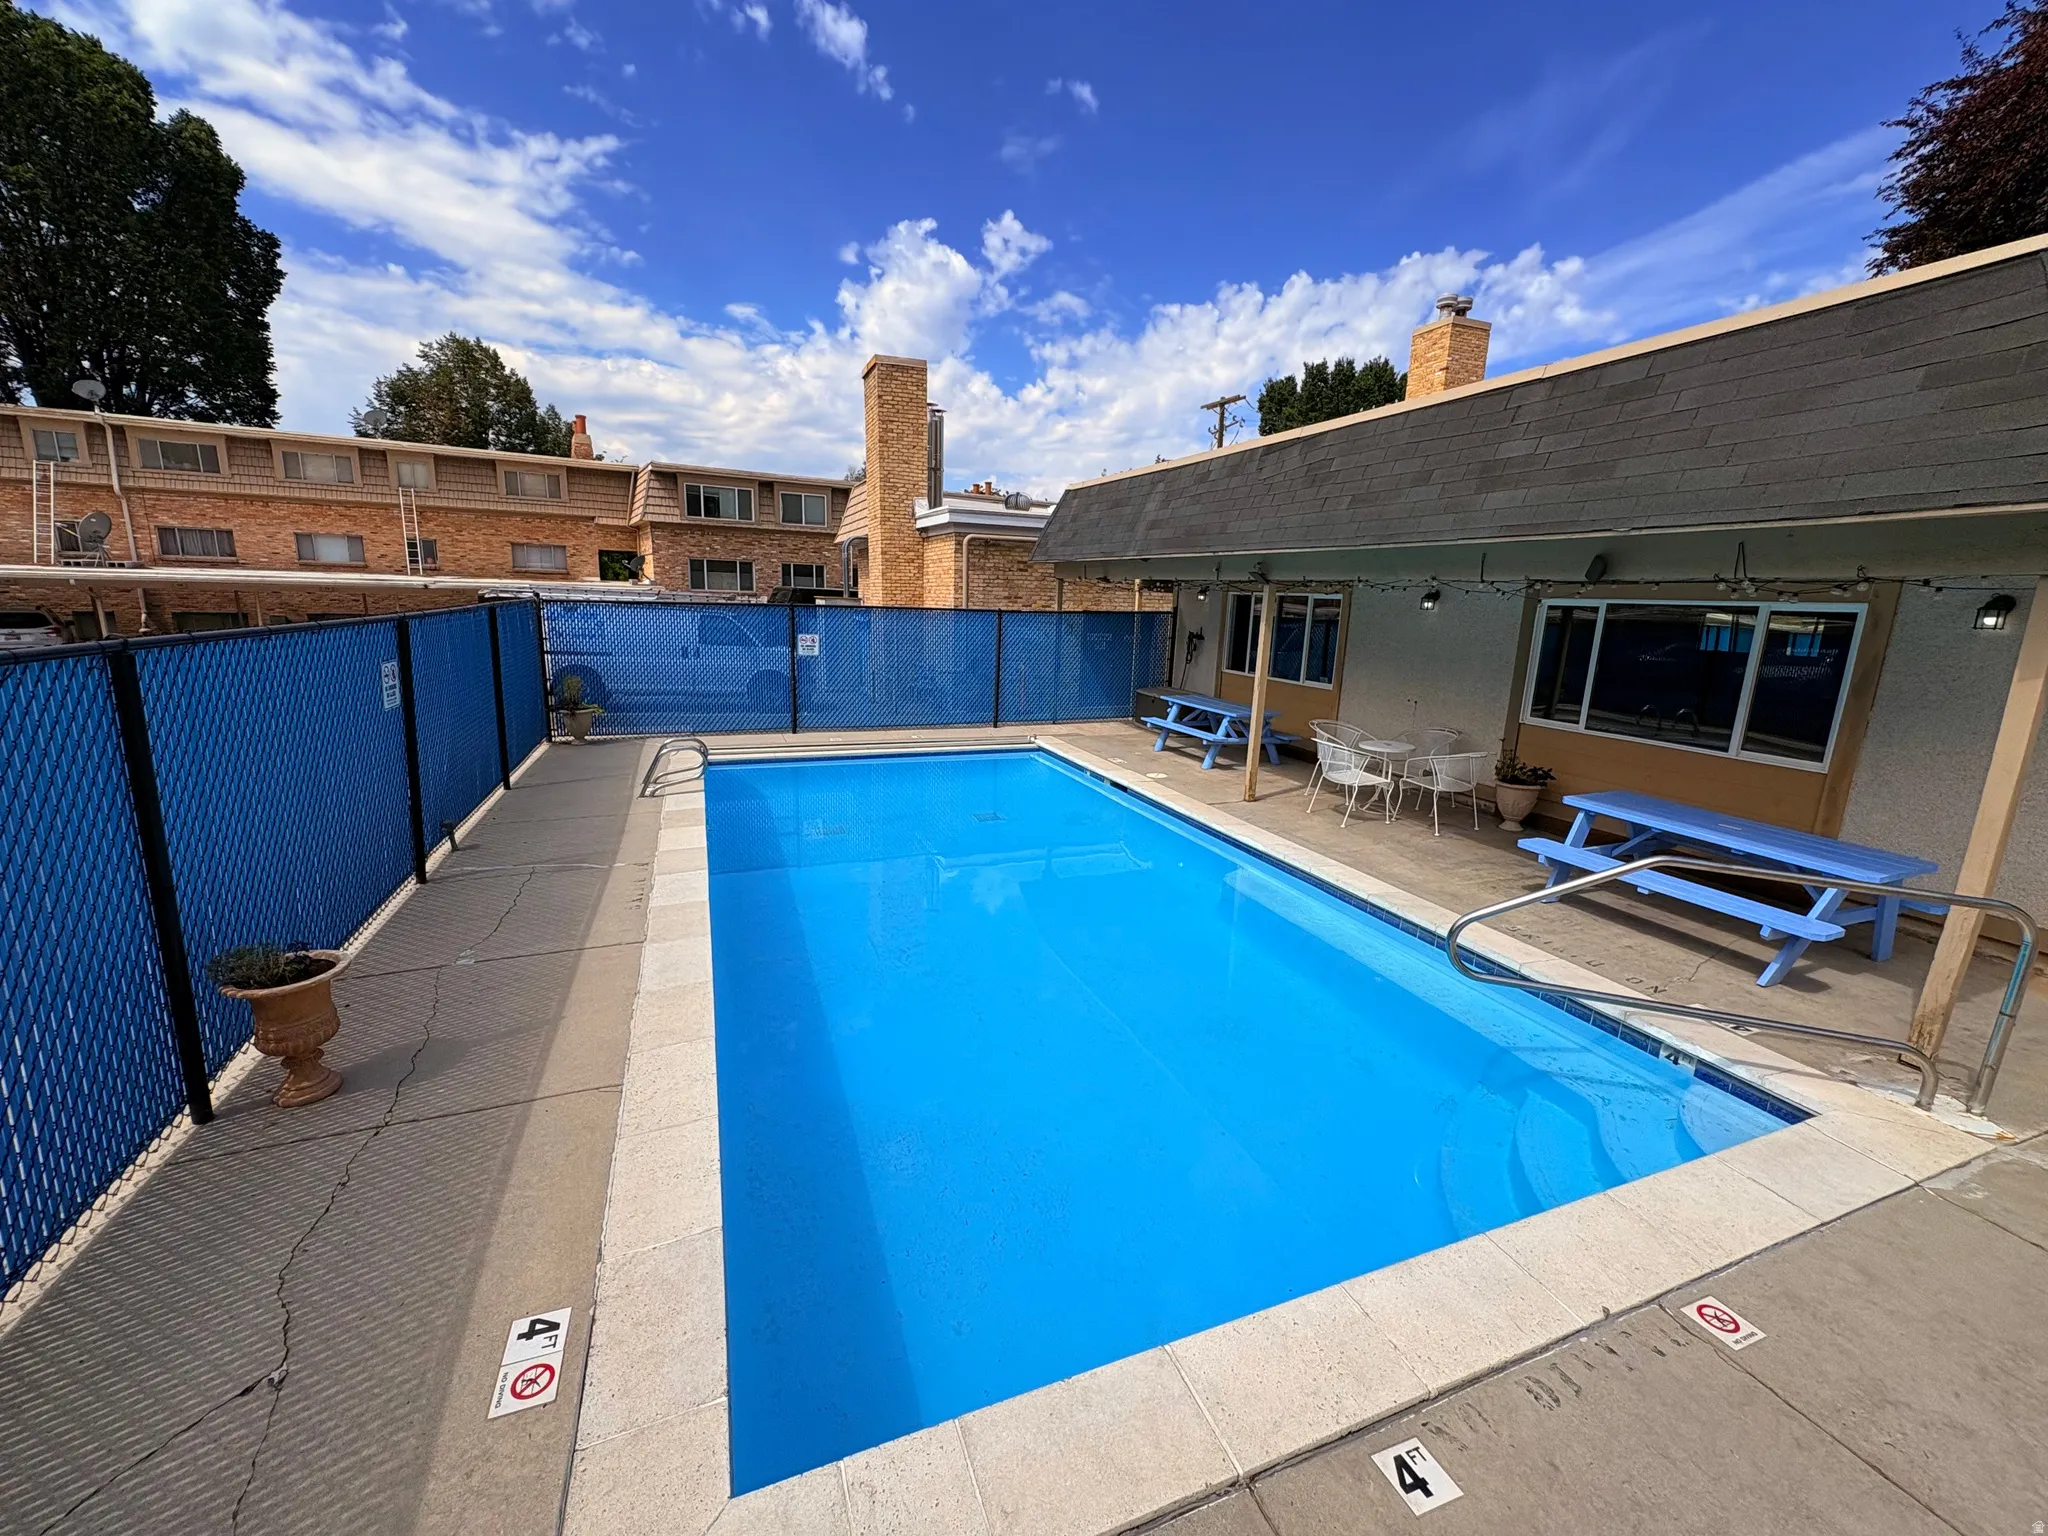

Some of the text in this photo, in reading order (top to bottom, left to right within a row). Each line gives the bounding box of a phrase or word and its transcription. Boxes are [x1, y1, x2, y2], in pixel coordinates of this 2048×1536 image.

[516, 1317, 561, 1349] 4 FT
[495, 1371, 509, 1409] NO DIVING
[1393, 1446, 1434, 1498] 4 FT
